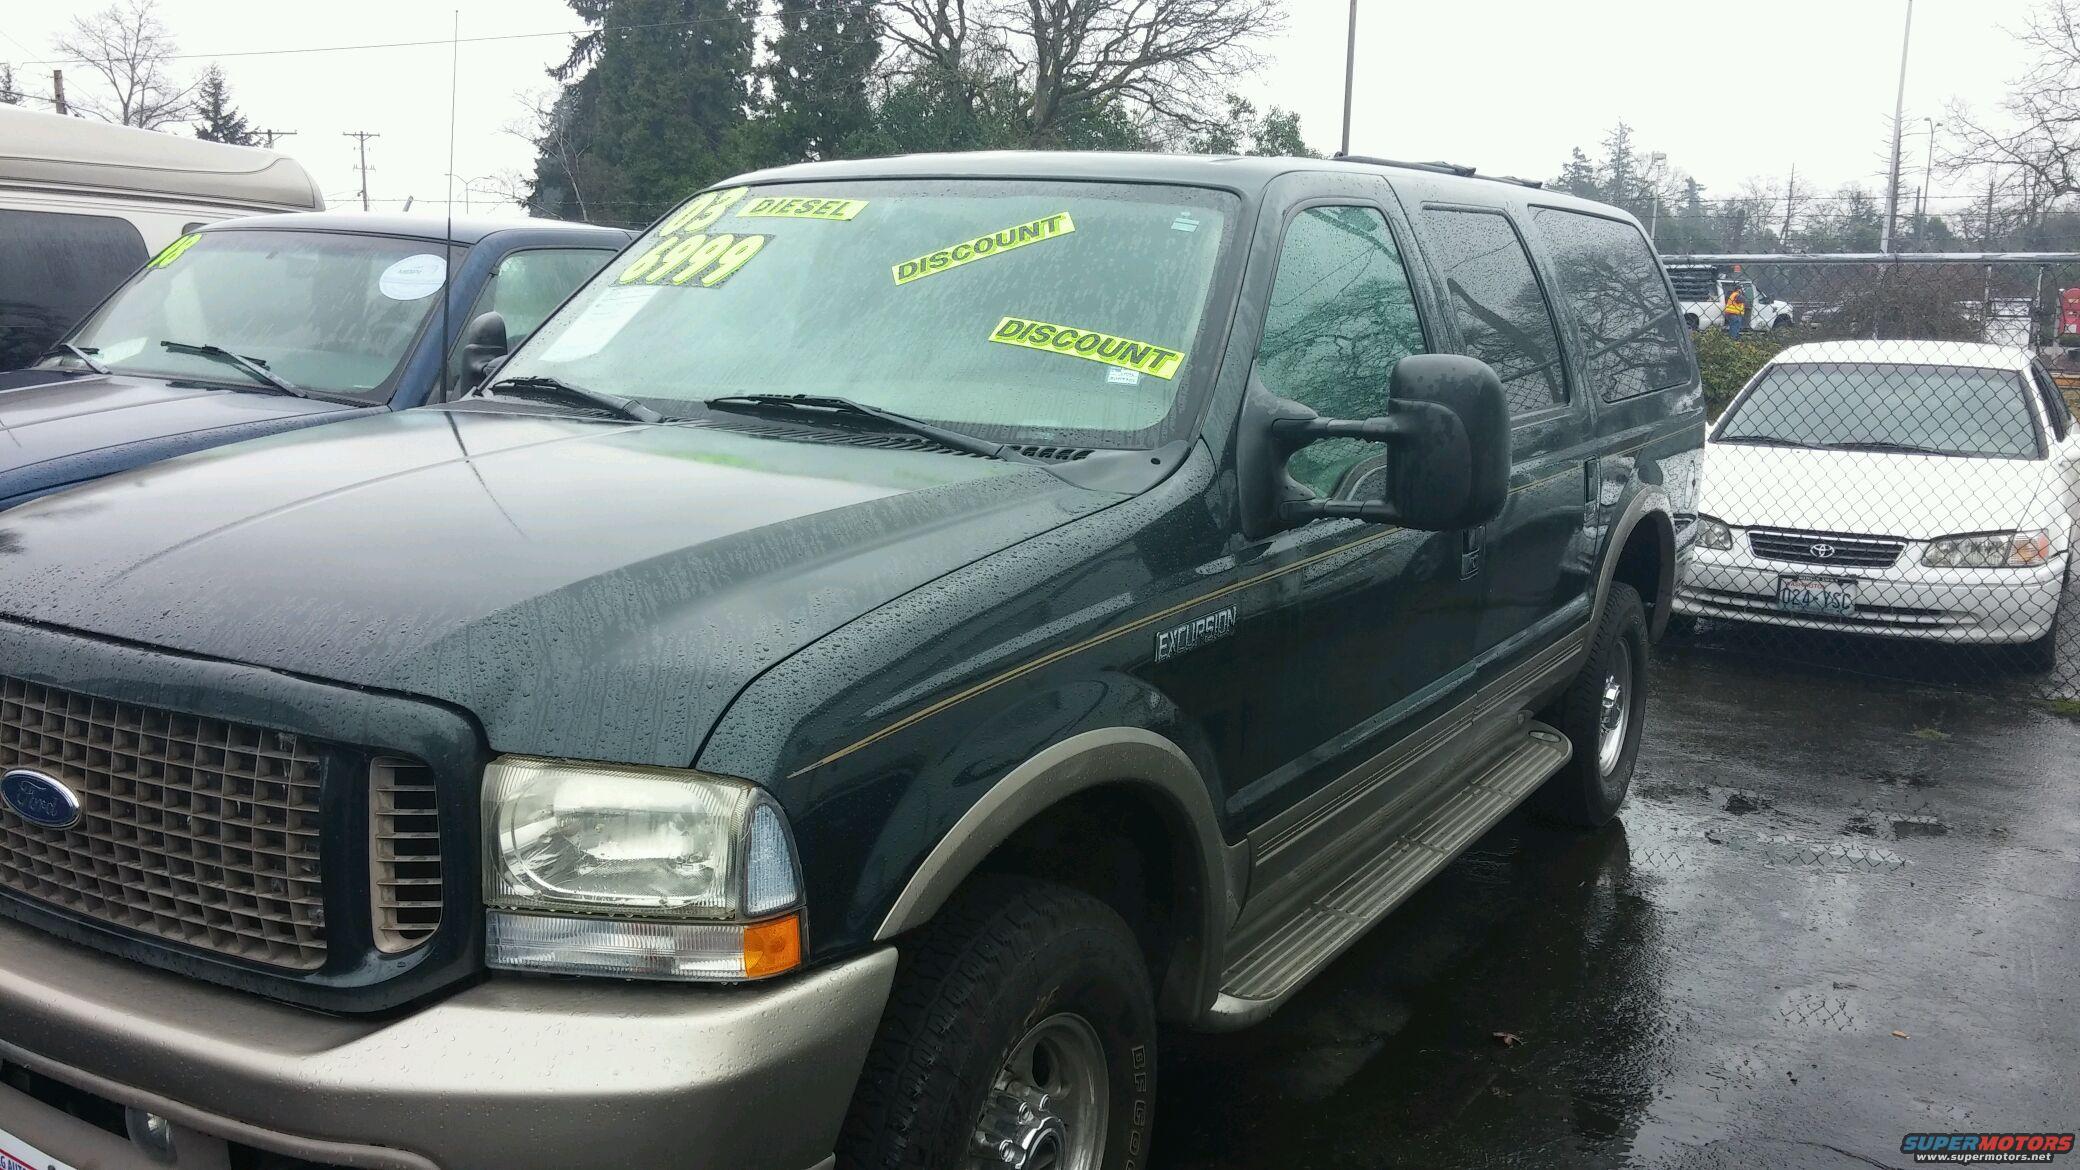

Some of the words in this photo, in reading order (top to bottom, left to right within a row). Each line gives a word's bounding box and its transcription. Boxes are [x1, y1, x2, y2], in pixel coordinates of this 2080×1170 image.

[750, 199, 851, 217] DIESEL
[618, 234, 765, 287] 6999
[898, 214, 1063, 281] DISCOUNT
[995, 319, 1179, 374] DISCOUNT
[1154, 605, 1237, 662] EXCURSION
